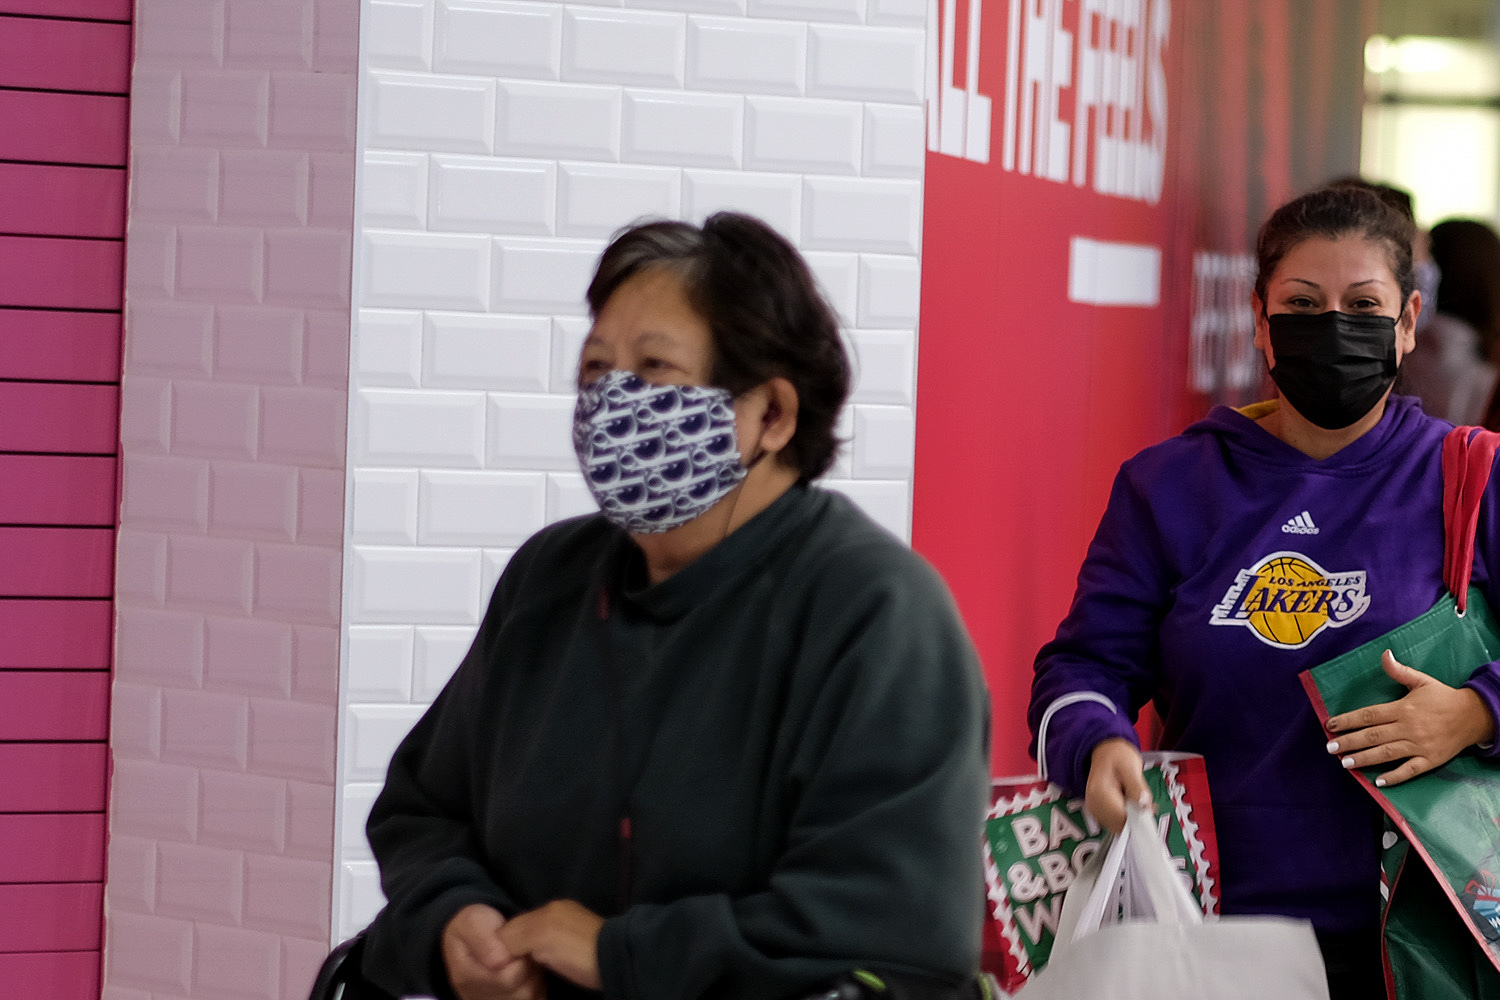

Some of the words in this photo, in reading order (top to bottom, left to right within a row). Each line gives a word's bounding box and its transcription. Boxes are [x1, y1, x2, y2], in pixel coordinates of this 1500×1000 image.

[926, 0, 992, 164] LL
[1217, 574, 1360, 622] LAKERS
[1269, 576, 1294, 586] LOS
[1296, 576, 1361, 587] ANGELES
[1011, 798, 1101, 859] BAT
